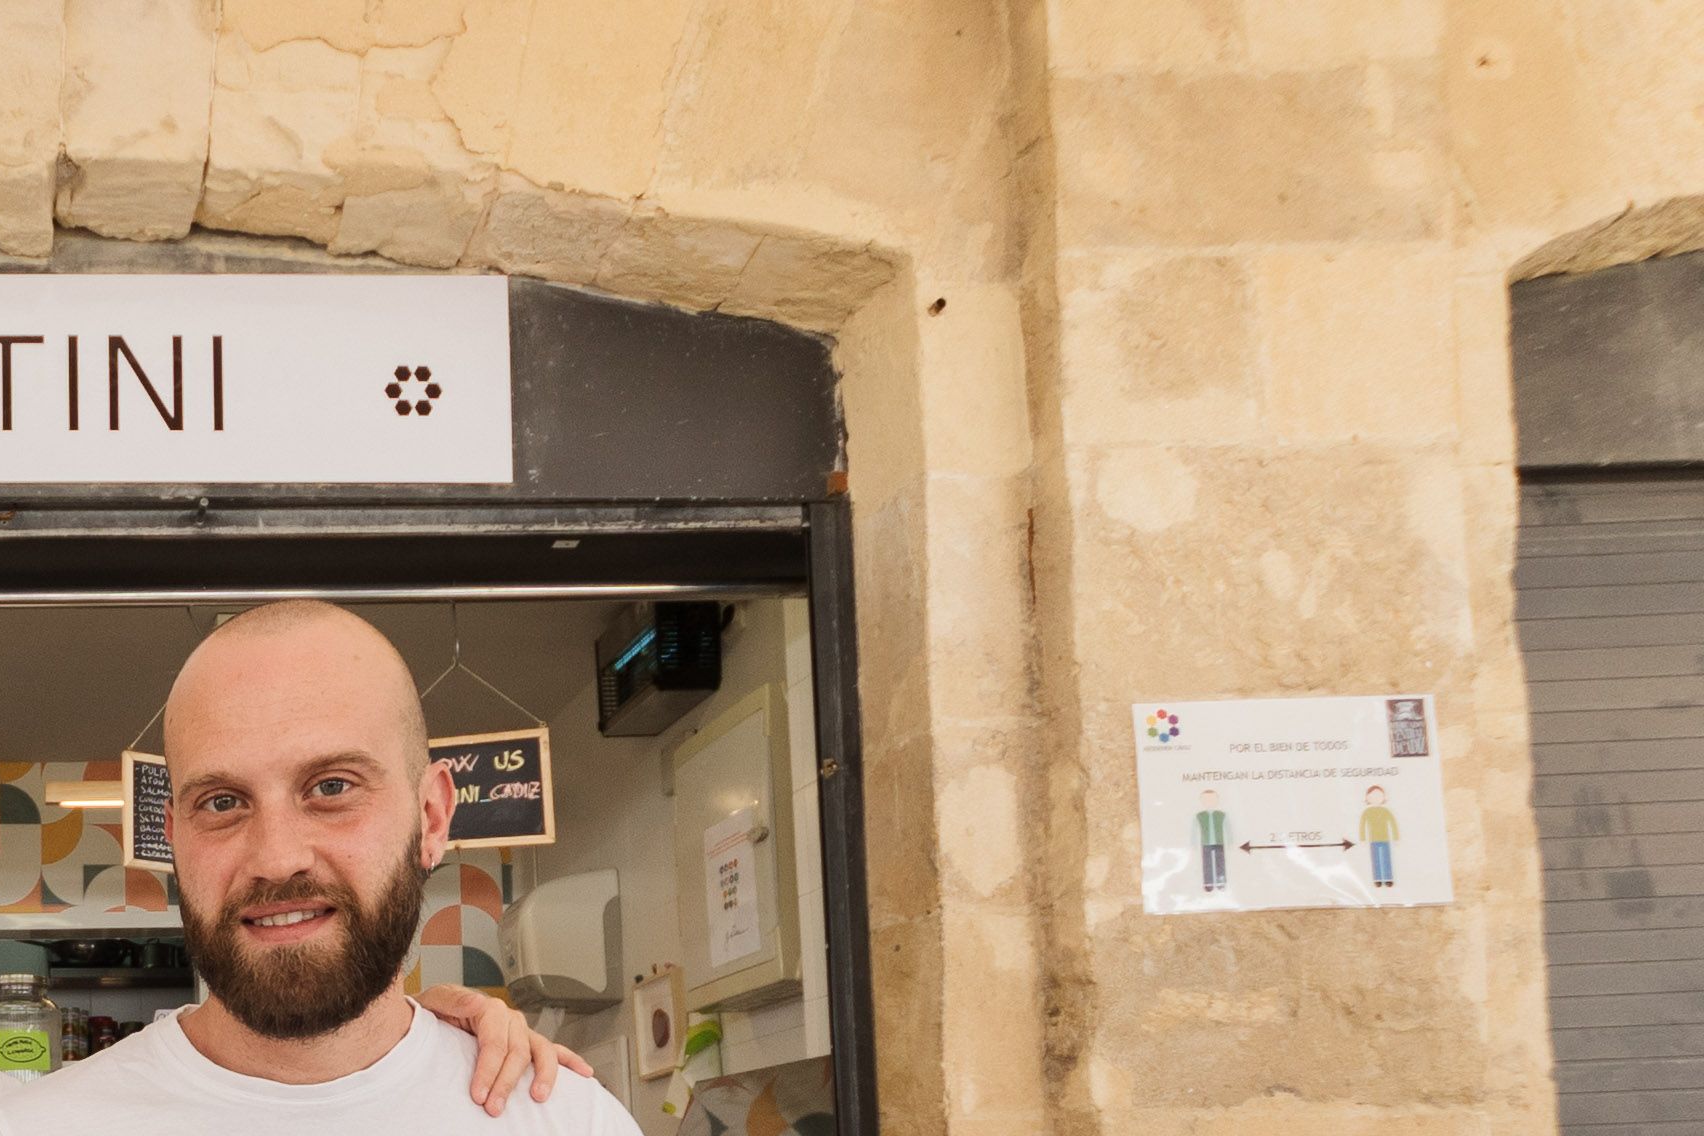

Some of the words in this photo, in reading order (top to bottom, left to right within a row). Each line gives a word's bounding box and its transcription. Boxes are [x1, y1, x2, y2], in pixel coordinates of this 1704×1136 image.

[1229, 743, 1251, 752] POR
[1254, 743, 1266, 752] EL
[1269, 742, 1293, 752] BIEN
[1295, 741, 1310, 751] DE
[1313, 740, 1349, 750] TODOS
[494, 749, 525, 771] US
[1182, 770, 1248, 782] MANTENGAN
[1251, 770, 1264, 780] LA
[1267, 769, 1319, 780] DISTANCIA
[1323, 768, 1337, 777] DE
[1341, 766, 1400, 778] SEGURIDAD
